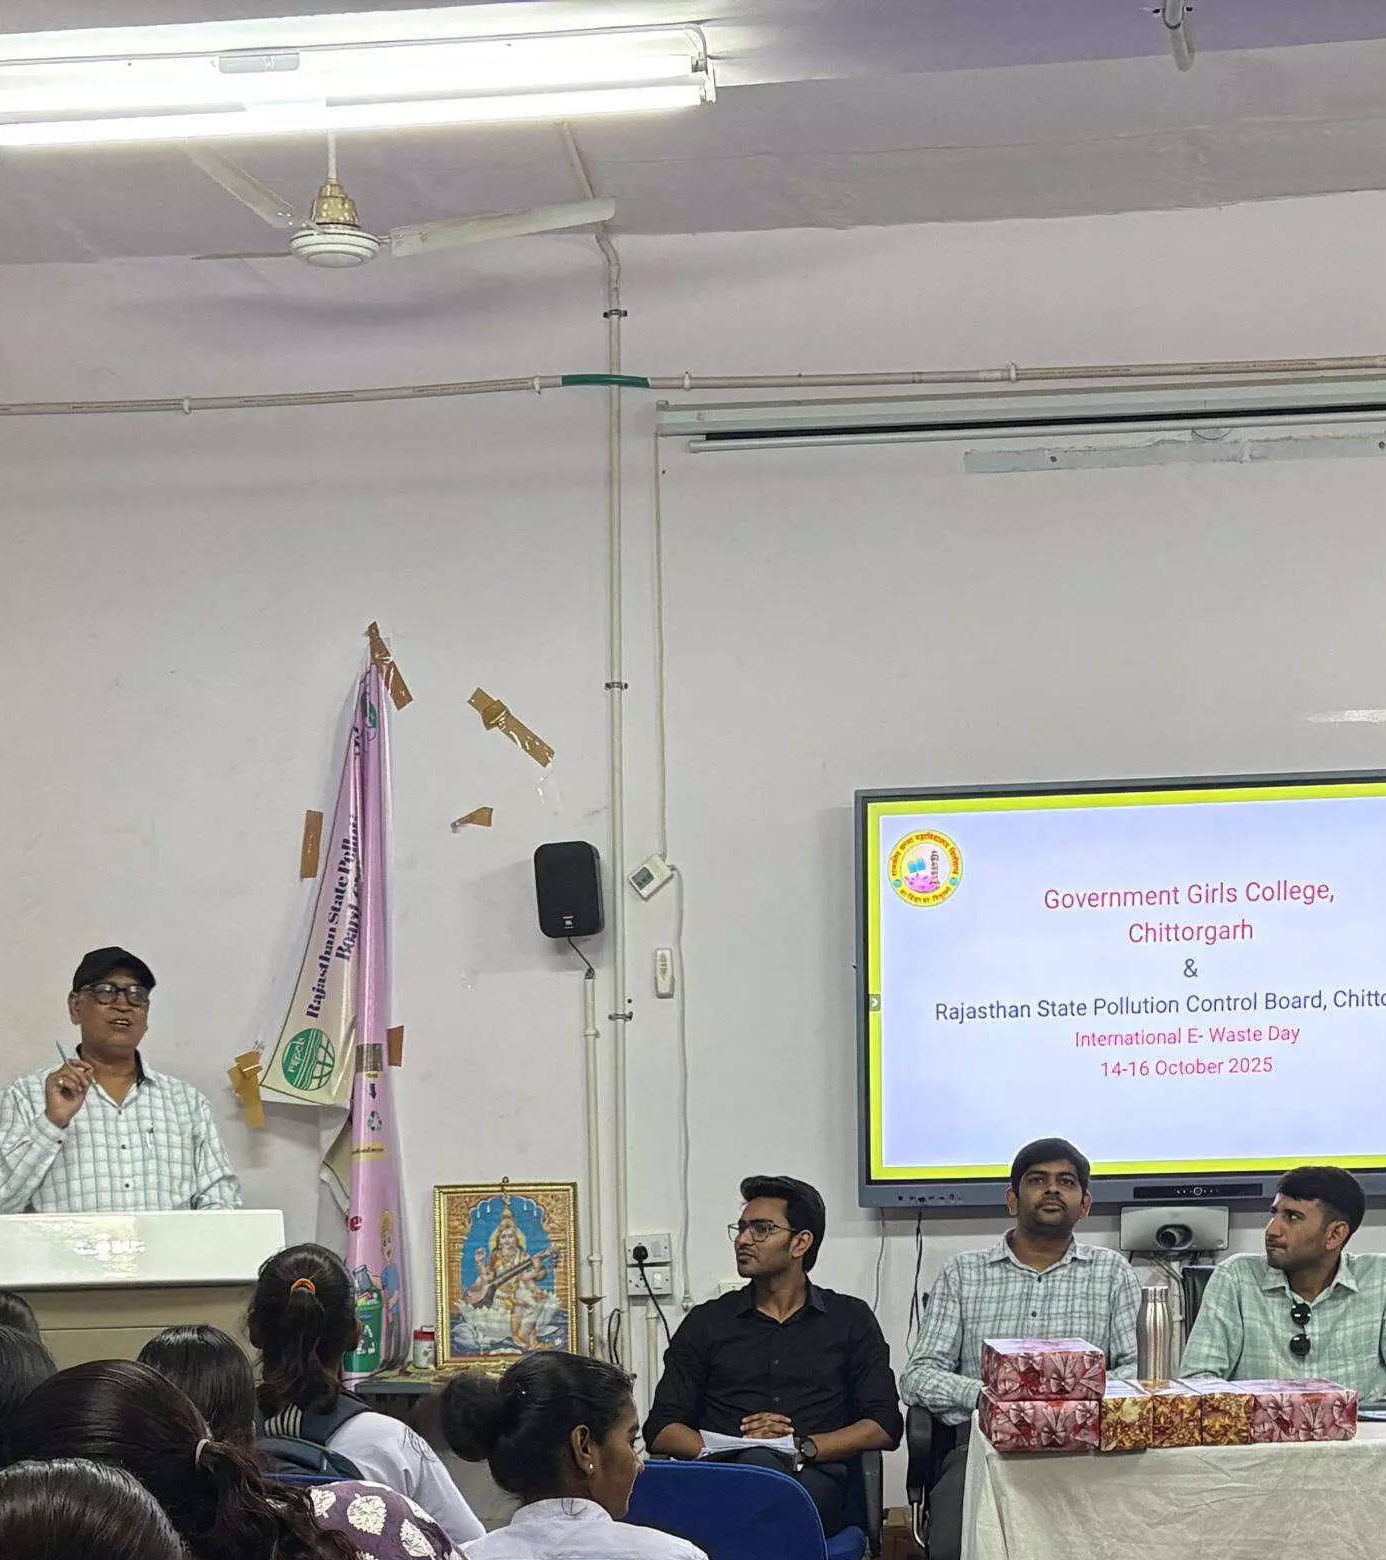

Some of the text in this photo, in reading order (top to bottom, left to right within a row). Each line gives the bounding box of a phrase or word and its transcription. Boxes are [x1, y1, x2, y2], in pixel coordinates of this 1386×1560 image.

[1044, 880, 1334, 909] Government Girls College,
[1129, 919, 1253, 945] Chittorgarh
[306, 927, 337, 1018] Rajasthan
[328, 876, 349, 925] State
[1183, 958, 1198, 978] &
[936, 1001, 1031, 1024] Rajasthan
[1037, 1000, 1087, 1017] State
[1094, 996, 1179, 1016] Pollution
[1186, 992, 1257, 1013] Control
[1265, 990, 1327, 1011] Board,
[1075, 1028, 1181, 1047] International
[1209, 1027, 1262, 1042] Waste
[1268, 1026, 1300, 1044] Day
[1101, 1057, 1273, 1077] 14-16 October 2025
